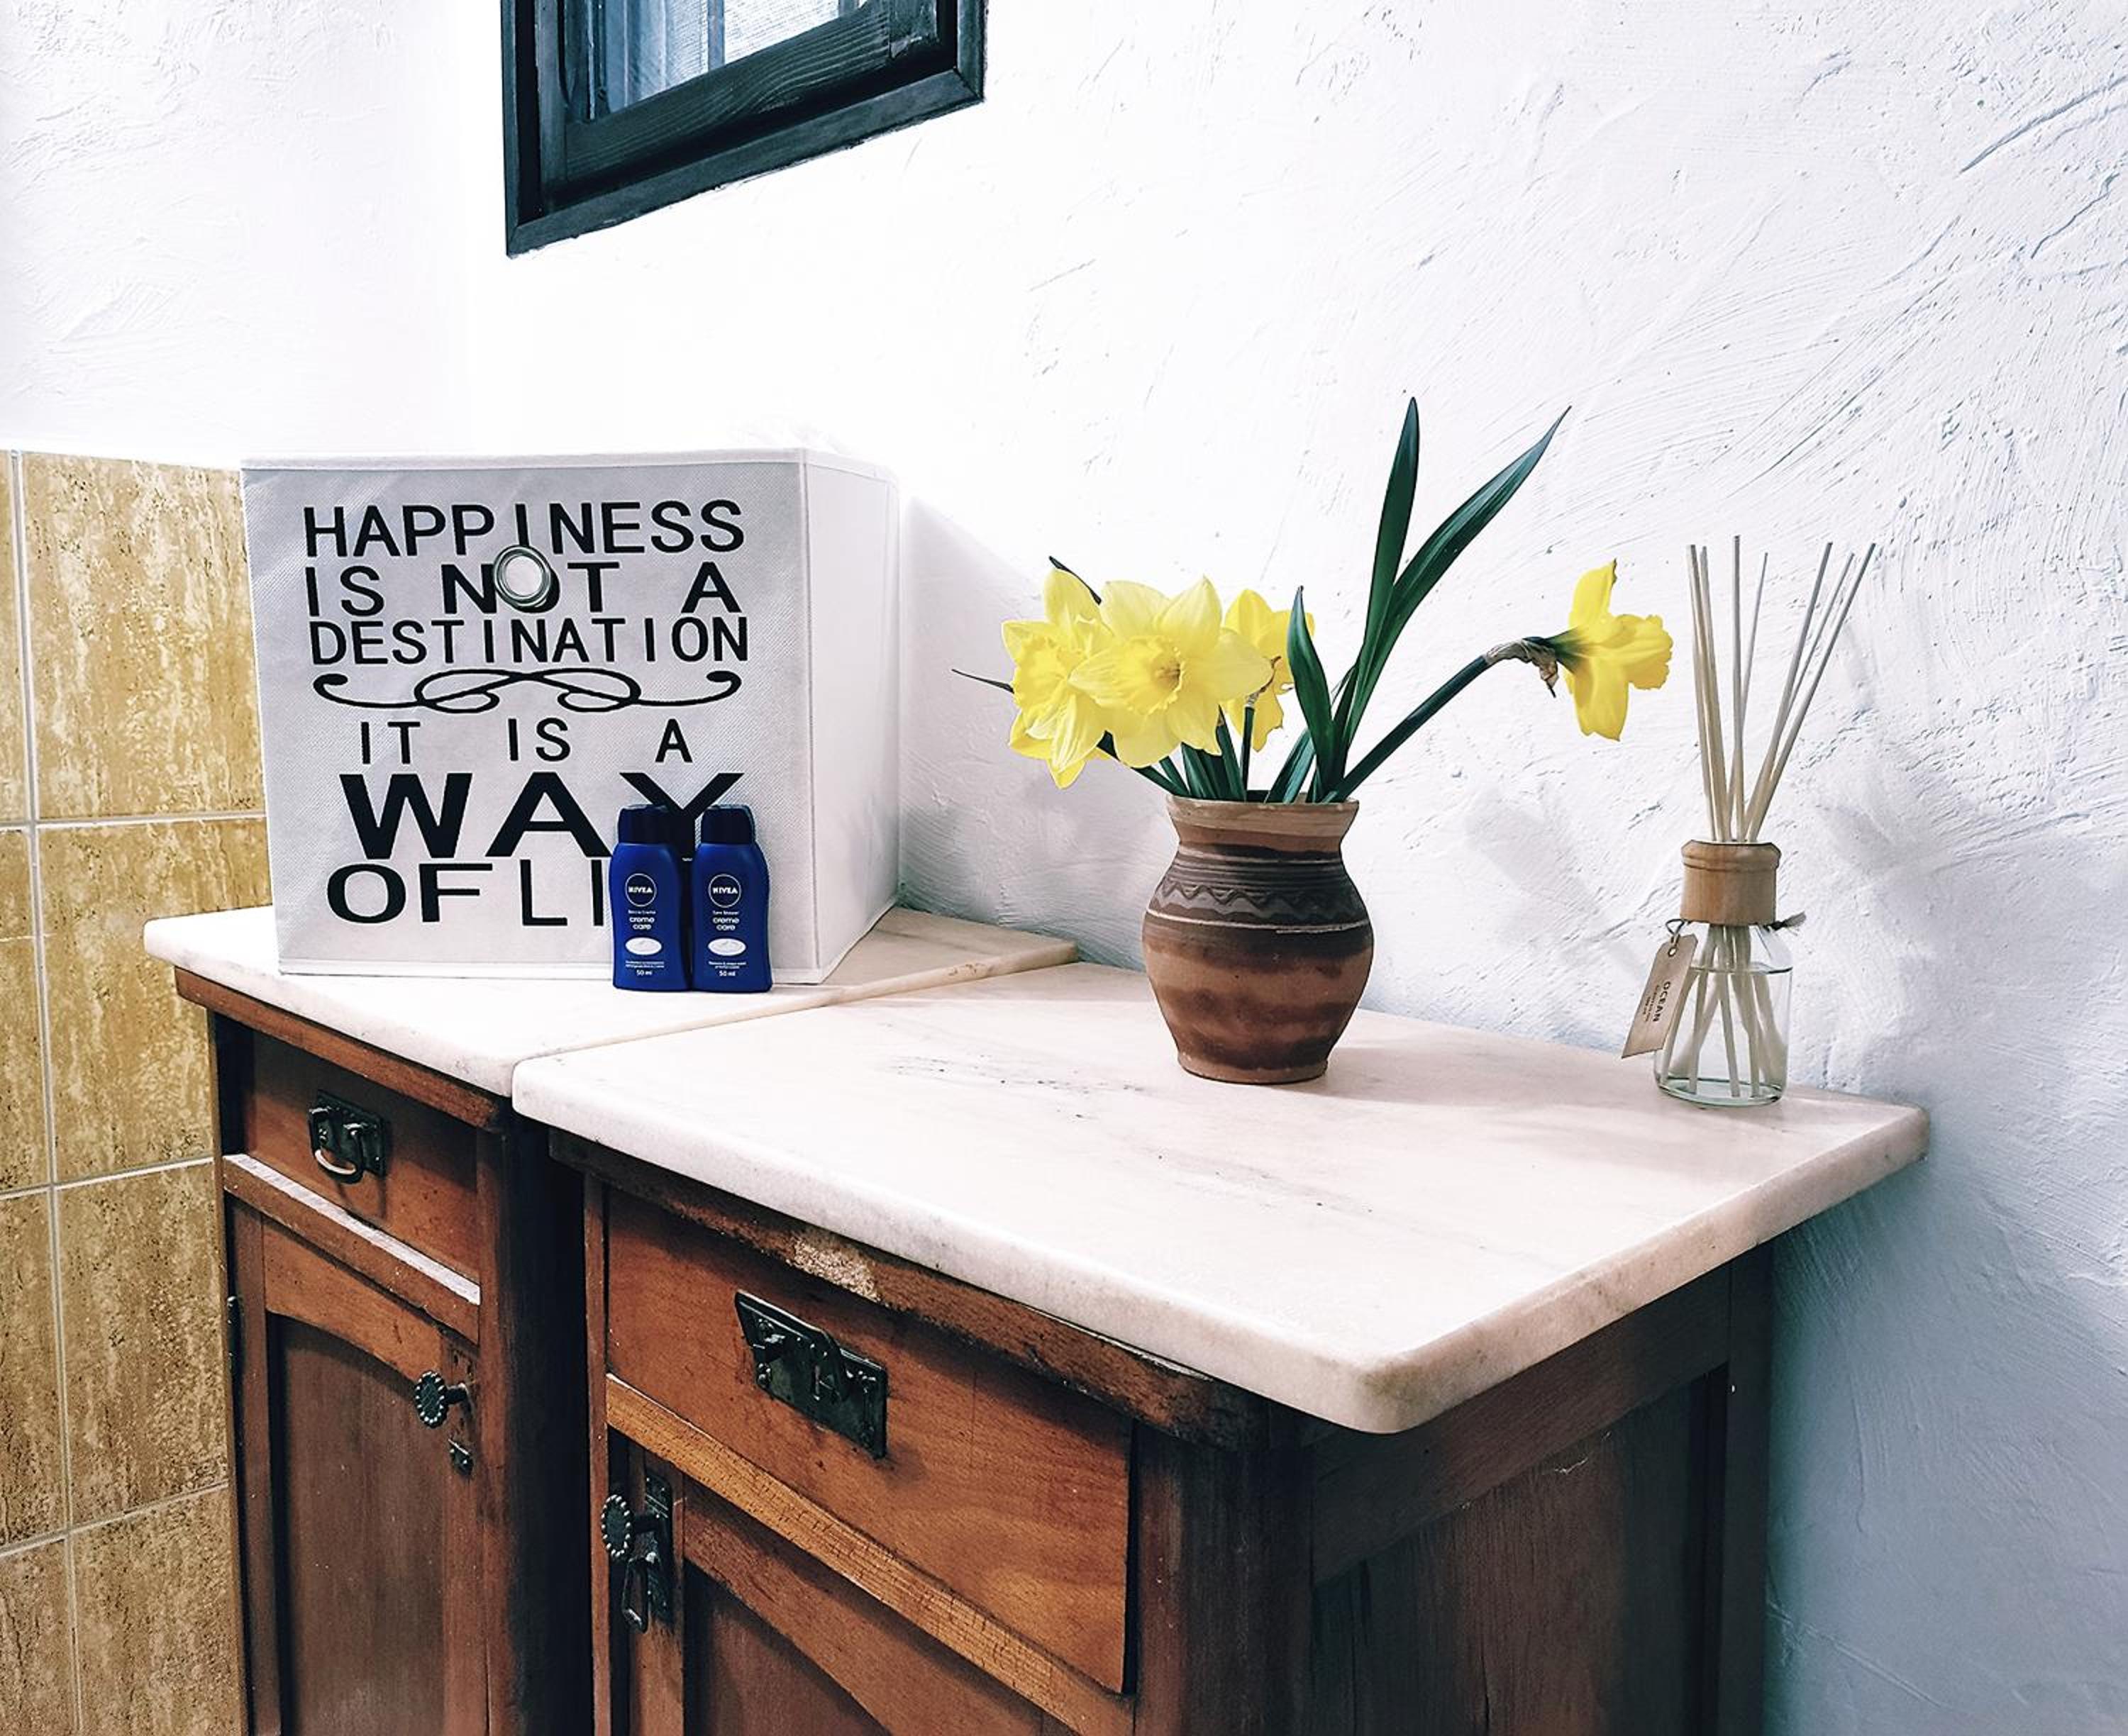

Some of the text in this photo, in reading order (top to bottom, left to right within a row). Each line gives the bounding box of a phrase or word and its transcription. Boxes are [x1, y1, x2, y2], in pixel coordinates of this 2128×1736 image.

[303, 499, 745, 557] HAPPINESS
[305, 565, 384, 617] IS
[680, 561, 742, 613] A
[309, 616, 748, 665] DESTINATION
[360, 718, 693, 764] IT IS A
[339, 772, 745, 860] WAY
[519, 859, 604, 927] LI
[1653, 981, 1671, 1022] OCEAN
